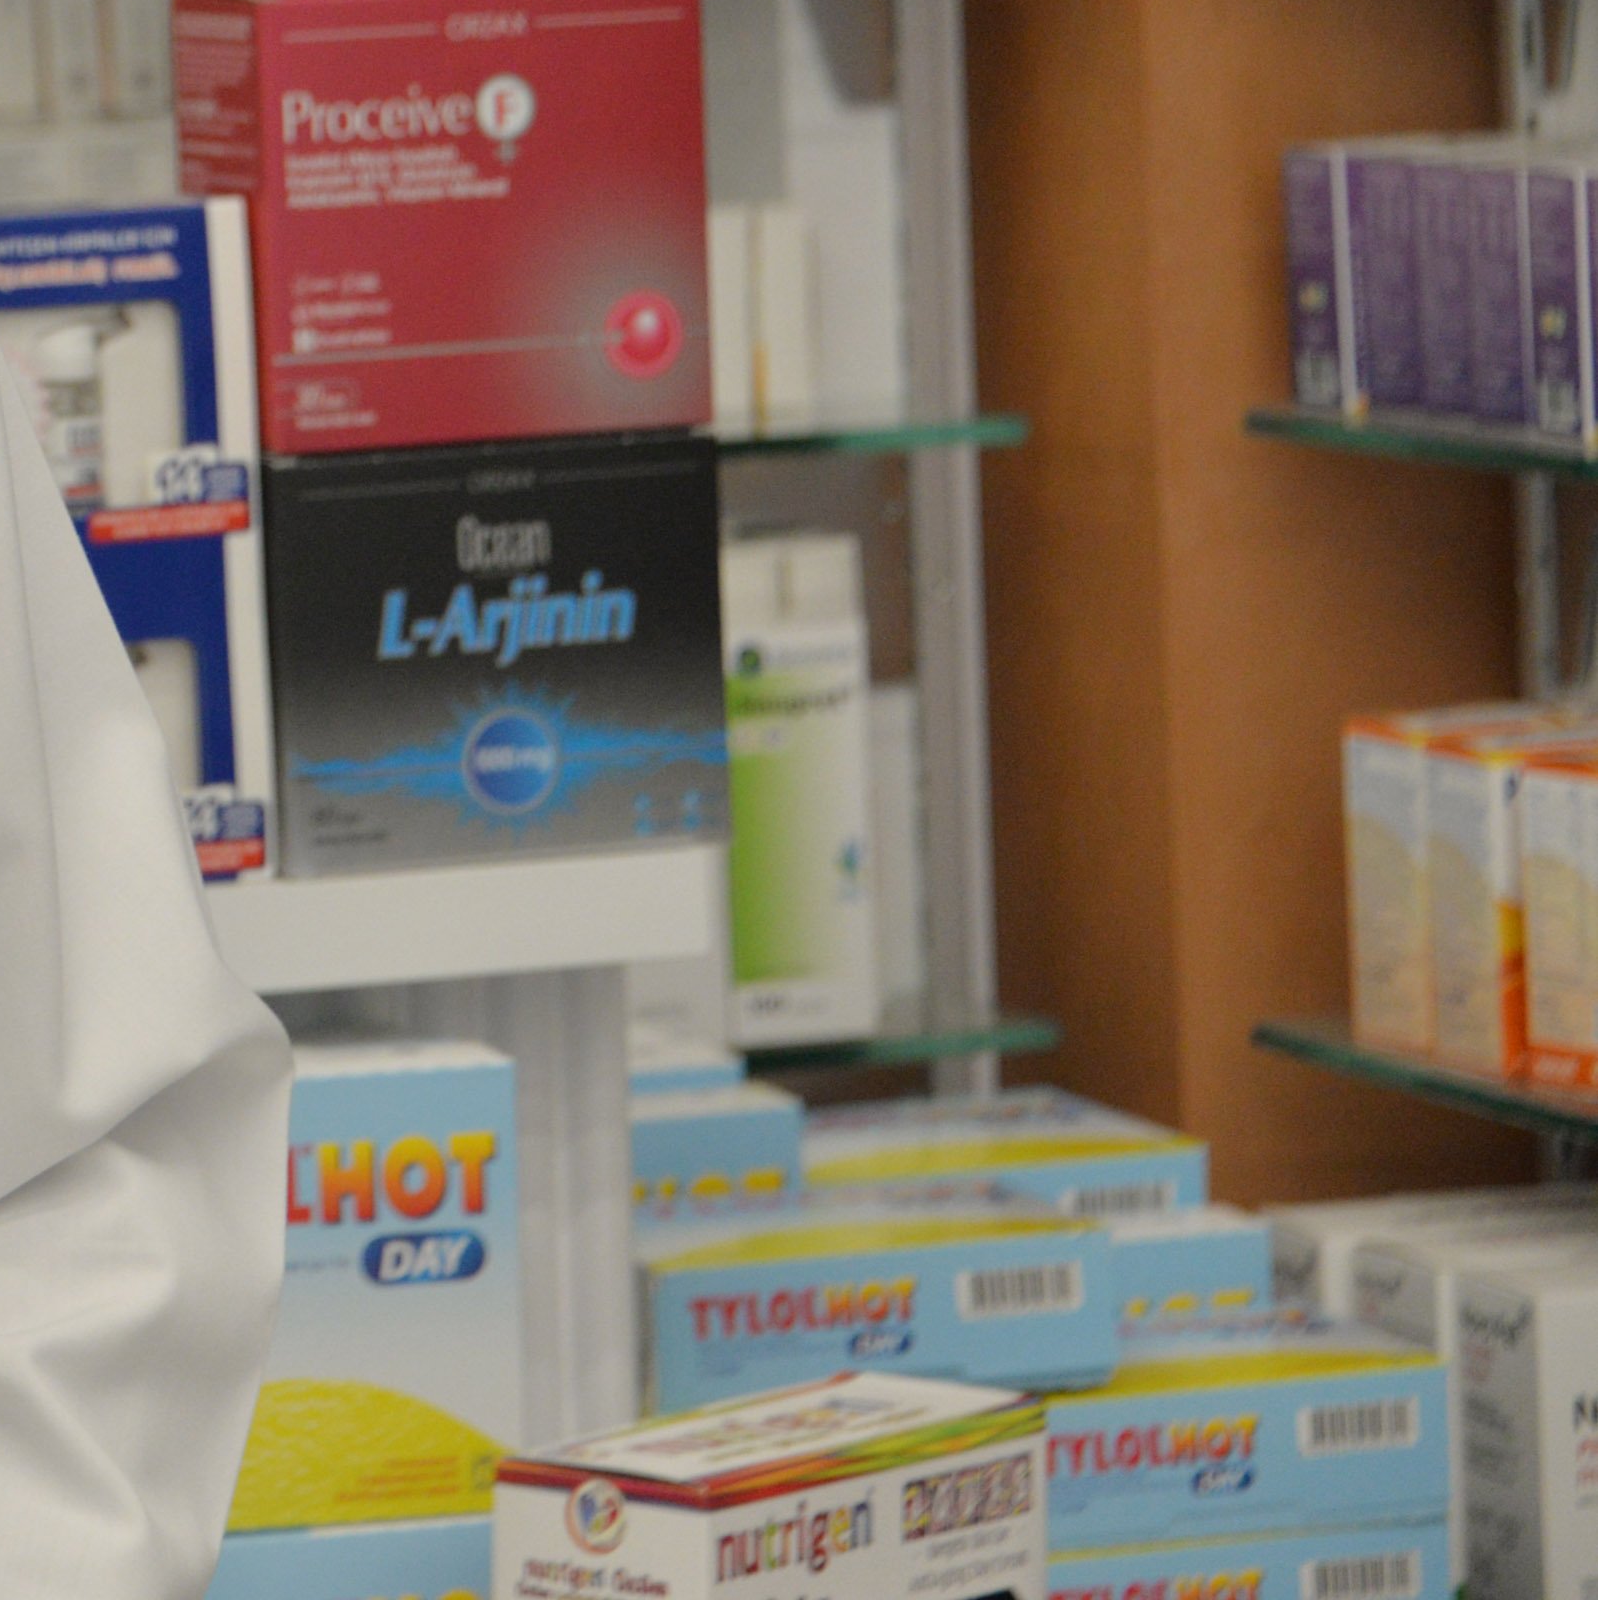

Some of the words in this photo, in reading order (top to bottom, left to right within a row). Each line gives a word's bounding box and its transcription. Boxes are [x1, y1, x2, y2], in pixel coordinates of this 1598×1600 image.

[282, 81, 474, 143] Proceive
[456, 514, 553, 571] Ocean
[378, 569, 637, 668] L-Arjinin
[378, 1236, 473, 1283] DAY
[689, 1275, 916, 1342] TYLOLHOT
[1046, 1412, 1260, 1479] TYLOLHOT
[716, 1497, 873, 1584] nutrigen
[1048, 1566, 1265, 1600] LHOT
